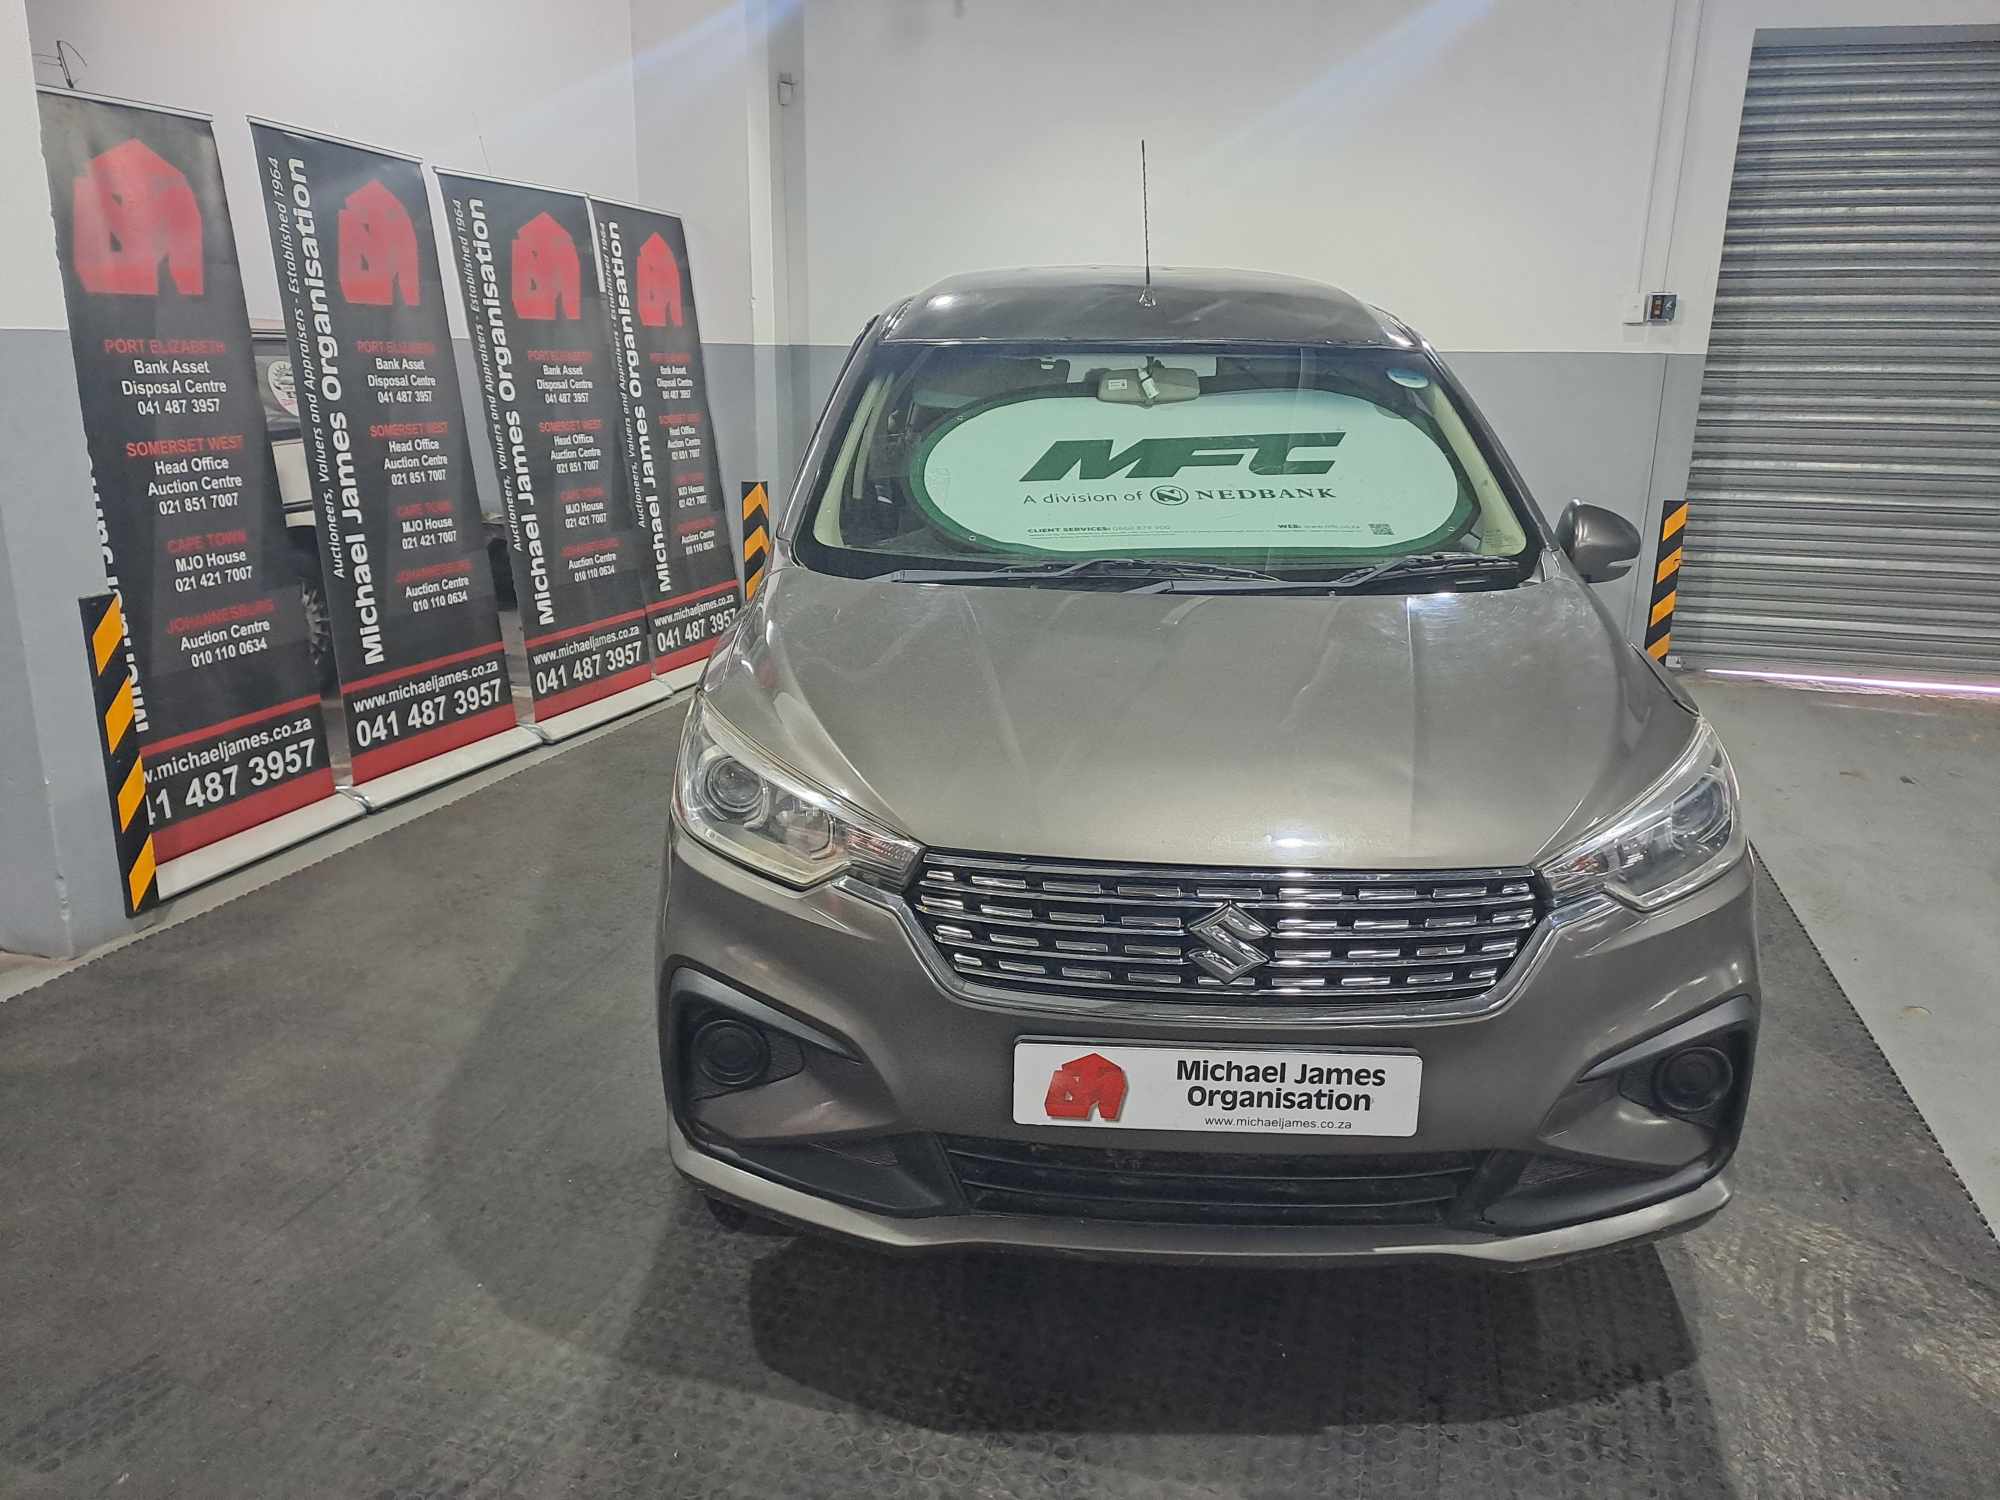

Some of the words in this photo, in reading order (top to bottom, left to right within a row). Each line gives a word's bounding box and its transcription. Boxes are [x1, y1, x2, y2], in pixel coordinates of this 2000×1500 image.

[268, 156, 286, 198] 1964
[275, 201, 300, 294] Established
[287, 158, 342, 402] Organisation
[457, 235, 480, 313] Established
[468, 198, 516, 402] Organisation
[608, 221, 643, 398] Organisation
[296, 304, 316, 390] Appraisers
[476, 323, 496, 395] Appraisers
[614, 330, 628, 390] Appraisers
[134, 359, 169, 374] Bank
[172, 359, 210, 374] Asset
[375, 358, 400, 370] Bank
[401, 358, 425, 370] Asset
[121, 380, 181, 398] Disposal
[184, 379, 227, 394] Centre
[367, 375, 409, 389] Disposal
[410, 375, 437, 387] Centre
[377, 391, 394, 403] 041
[396, 391, 413, 402] 487
[415, 390, 433, 402] 3957
[137, 400, 161, 415] 041
[164, 399, 187, 414] 487
[191, 398, 220, 413] 3957
[304, 392, 322, 424] and
[485, 394, 500, 420] and
[619, 391, 631, 415] and
[388, 440, 413, 453] Head
[414, 438, 440, 451] Office
[491, 421, 508, 470] Valuers
[624, 417, 636, 458] Valuers
[634, 405, 656, 489] James
[154, 460, 188, 475] Head
[191, 457, 229, 472] Office
[312, 427, 331, 484] Valuers
[329, 411, 362, 525] James
[383, 456, 420, 470] Auction
[421, 454, 448, 466] Centre
[505, 410, 534, 506] James
[550, 450, 578, 461] Auction
[1019, 431, 1347, 482] MFC
[148, 479, 199, 497] Auction
[201, 475, 243, 491] Centre
[391, 473, 408, 486] 021
[409, 471, 426, 484] 851
[427, 468, 447, 481] 7007
[159, 499, 182, 515] 021
[184, 497, 207, 513] 851
[210, 492, 240, 508] 7007
[631, 462, 646, 528] Auctioneers,
[1023, 495, 1037, 505] A
[1043, 491, 1117, 504] division
[1123, 490, 1144, 502] of
[1195, 487, 1337, 500] NEDBANK
[401, 519, 423, 534] MJO
[424, 517, 454, 531] House
[502, 475, 522, 551] Auctioneers,
[322, 487, 345, 578] Auctioneers,
[401, 537, 418, 550] 021
[419, 534, 436, 547] 421
[437, 530, 457, 543] 7007
[645, 494, 672, 593] Michael
[174, 556, 203, 573] MJO
[206, 550, 248, 568] House
[520, 513, 555, 627] Michael
[568, 555, 594, 570] Auction
[175, 576, 197, 593] 021
[199, 572, 223, 588] 421
[224, 566, 253, 583] 7007
[405, 581, 440, 598] Auction
[441, 575, 470, 590] Centre
[344, 532, 385, 666] Michael
[412, 599, 430, 613] 010
[430, 595, 447, 609] 110
[447, 590, 468, 604] 0634
[654, 593, 735, 627] www.michaeljames.co.za
[180, 630, 229, 651] Auction
[230, 619, 271, 639] Centre
[533, 625, 640, 666] www.michaeljames.co.za
[656, 626, 681, 652] 041
[684, 619, 706, 642] 487
[709, 607, 736, 635] 3957
[190, 651, 214, 668] 010
[214, 643, 237, 661] 110
[238, 636, 269, 655] 0634
[536, 664, 568, 695] 041
[572, 653, 602, 682] 487
[605, 640, 643, 672] 3957
[353, 660, 499, 714] www.michaeljames.co.za
[356, 710, 399, 747] 041
[407, 695, 447, 729] 487
[453, 678, 502, 715] 3957
[185, 764, 239, 808] 487
[248, 738, 316, 786] 3957
[1176, 1060, 1286, 1083] Michael
[1294, 1063, 1386, 1087] James
[1187, 1085, 1372, 1112] Organisation
[1205, 1115, 1353, 1130] www.michaeljames.co.za
